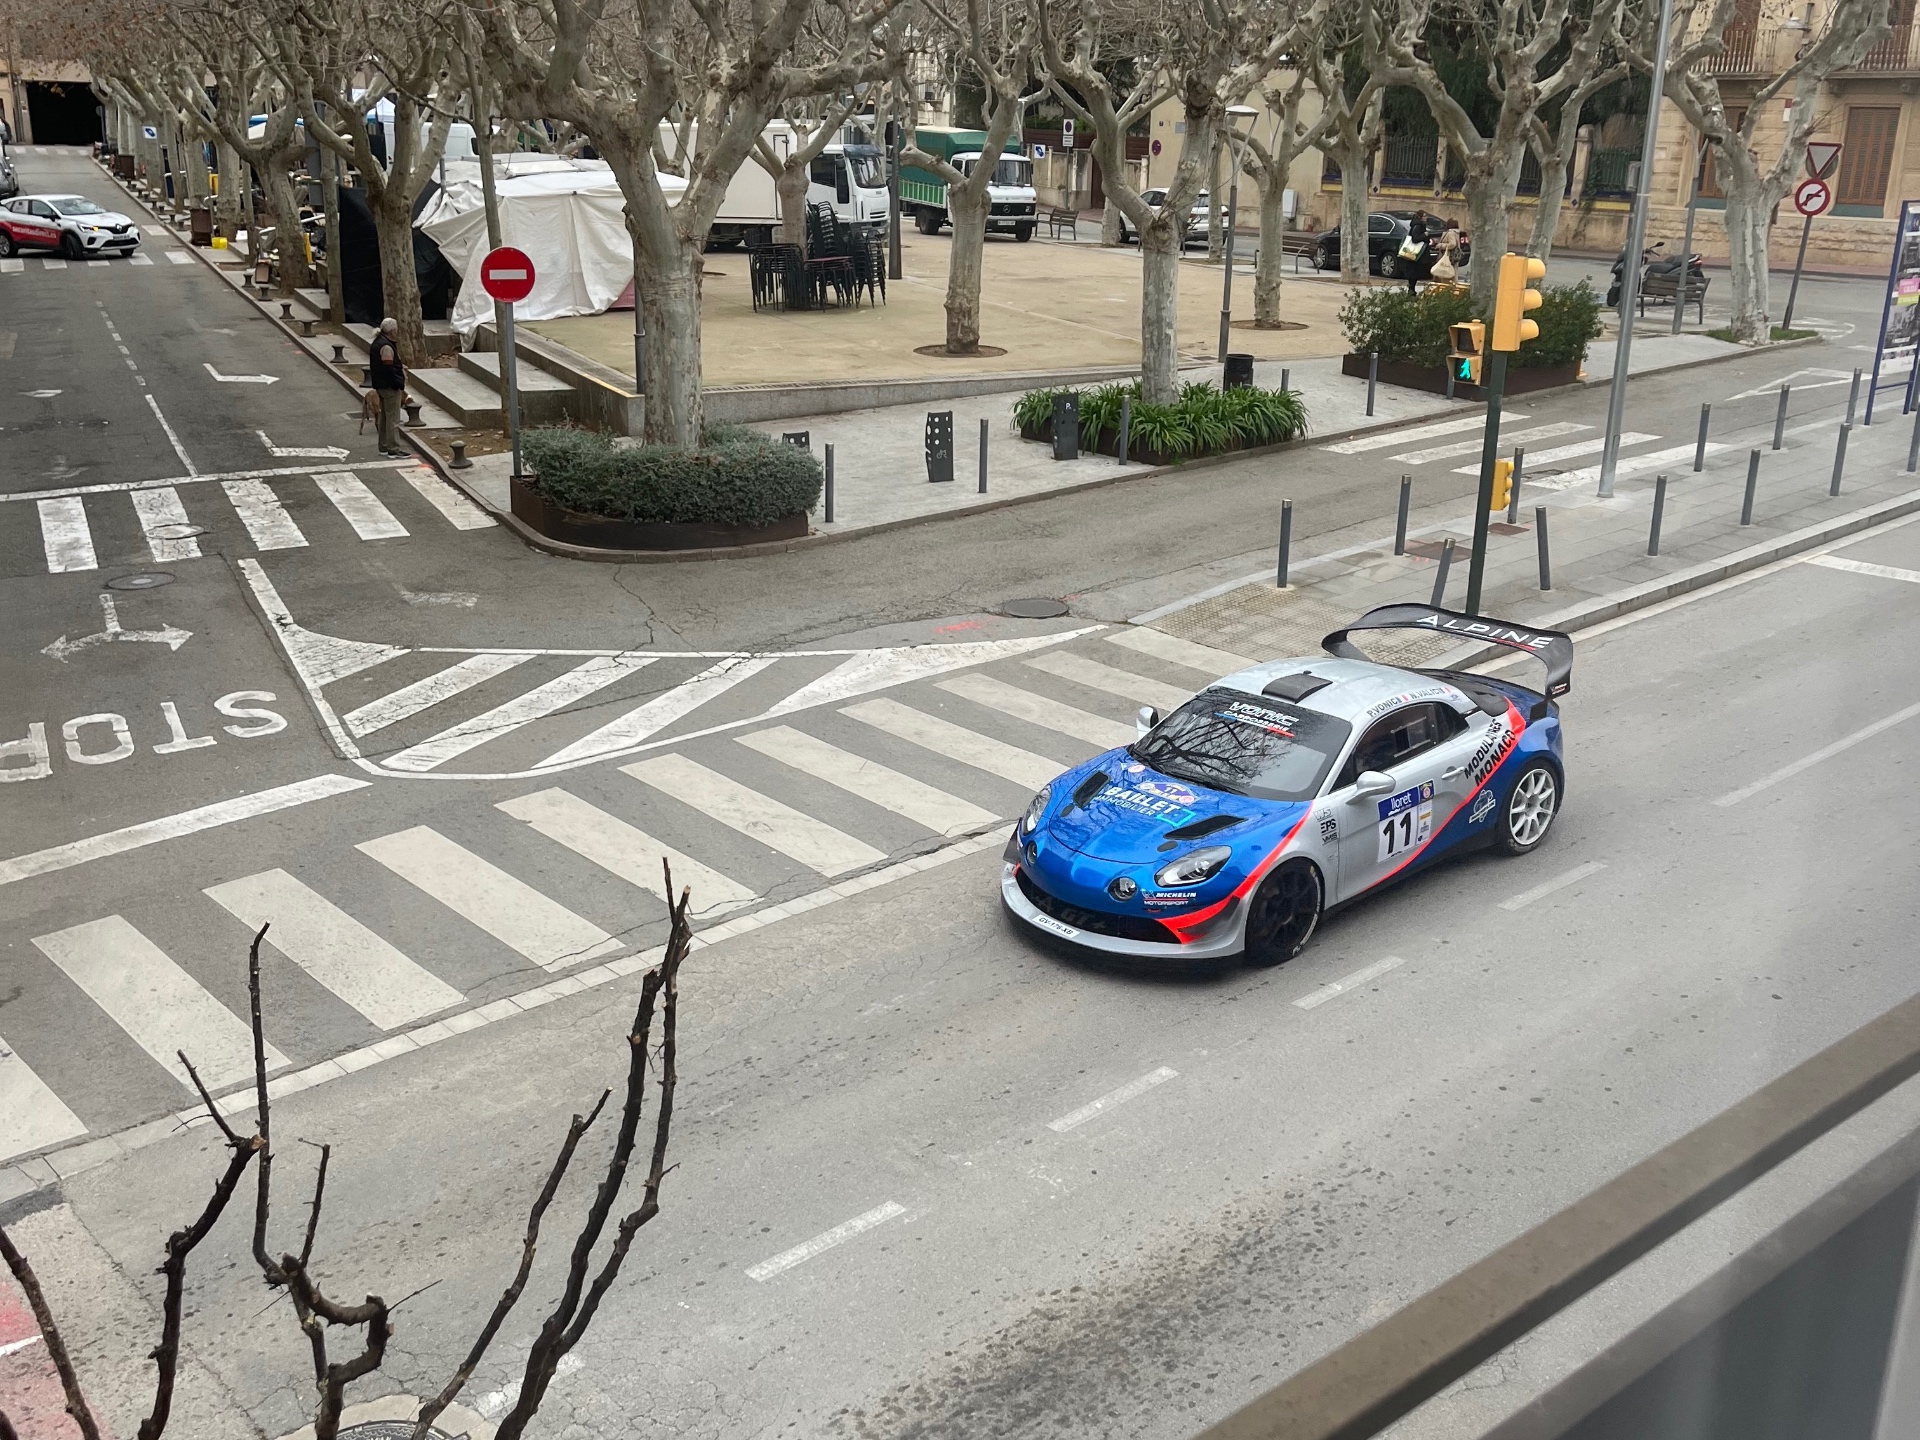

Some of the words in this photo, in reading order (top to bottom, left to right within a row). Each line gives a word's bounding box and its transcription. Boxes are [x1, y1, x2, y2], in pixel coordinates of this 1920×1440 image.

[1416, 614, 1554, 649] ALPINE
[0, 690, 288, 783] STOP
[1473, 729, 1517, 787] MONACO
[1096, 794, 1156, 817] IMMOBILIER
[1103, 786, 1181, 814] BAILLET
[1390, 792, 1412, 811] lloret
[1320, 818, 1337, 834] EPS
[1382, 811, 1412, 855] 11
